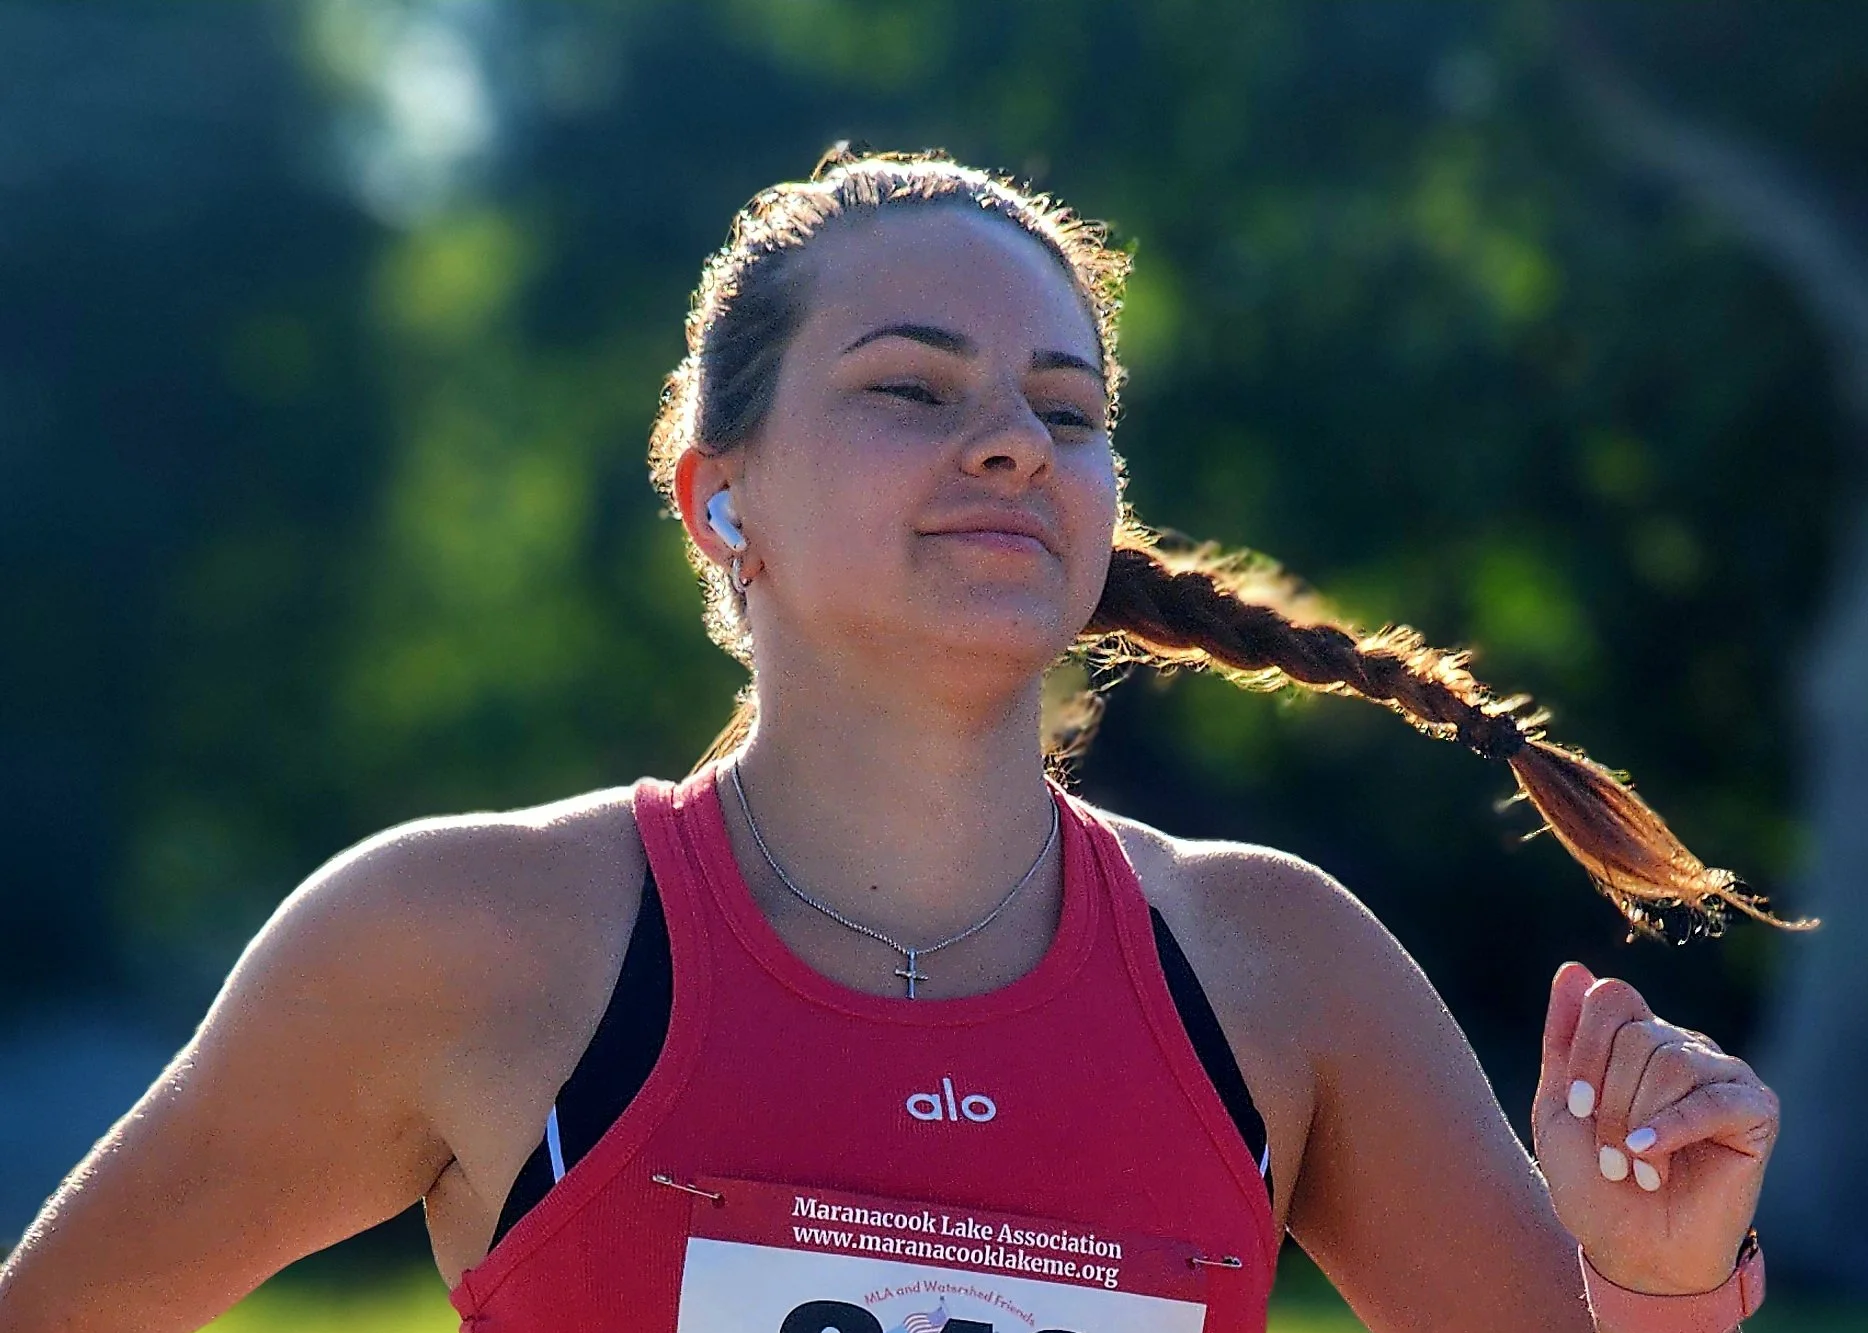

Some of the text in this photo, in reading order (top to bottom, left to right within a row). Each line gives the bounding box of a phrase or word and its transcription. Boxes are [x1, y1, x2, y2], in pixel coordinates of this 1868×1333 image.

[906, 1077, 997, 1122] alo
[791, 1196, 1122, 1260] Maranacook Lake Association
[792, 1226, 1120, 1289] www.maranacooklakeme.org
[864, 1287, 894, 1307] MLA
[896, 1281, 920, 1297] and
[994, 1296, 1036, 1328] Friends
